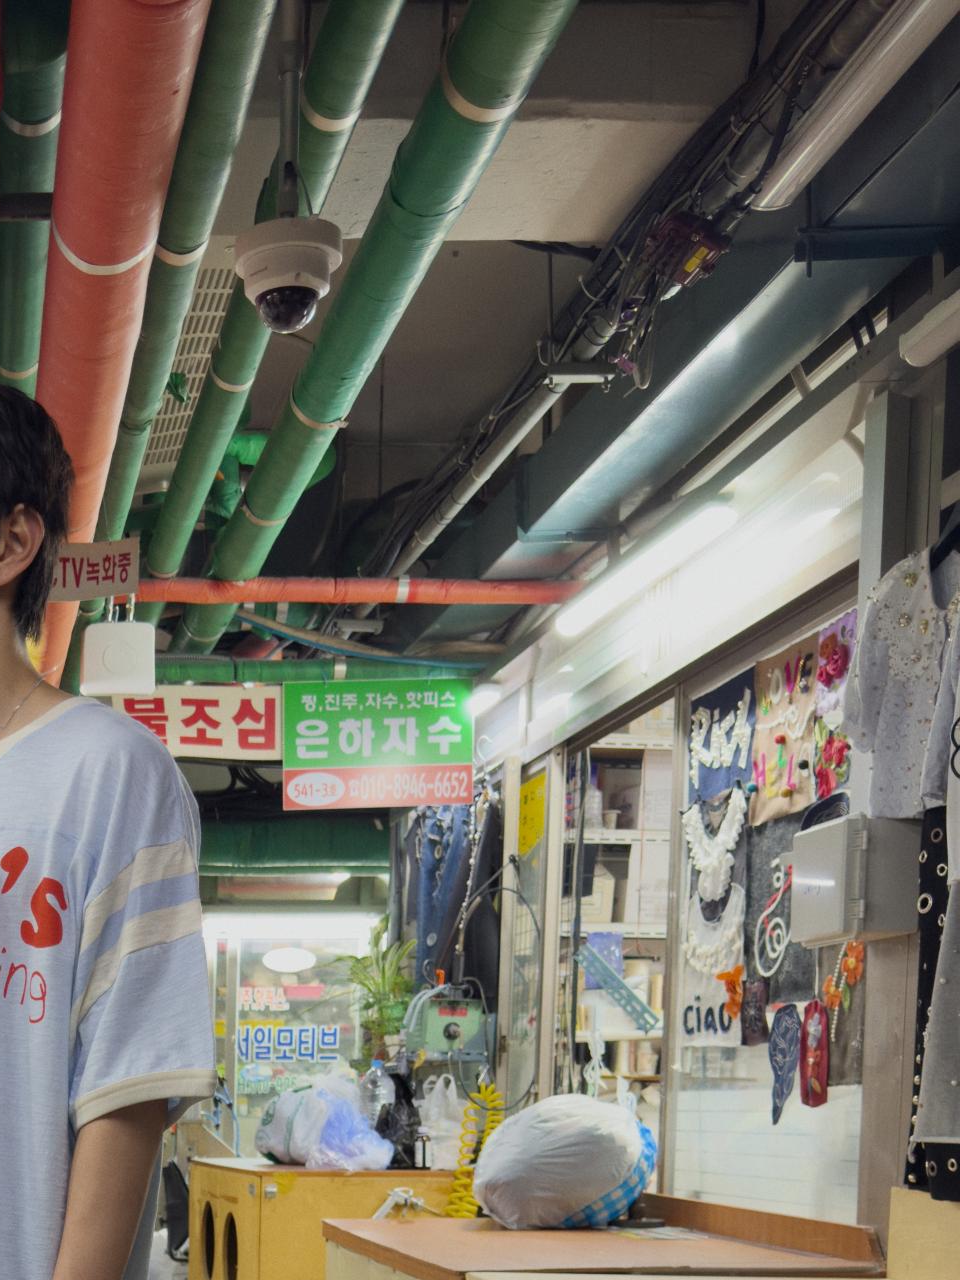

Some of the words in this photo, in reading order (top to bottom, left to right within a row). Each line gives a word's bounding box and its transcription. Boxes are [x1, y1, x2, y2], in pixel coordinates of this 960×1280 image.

[53, 552, 131, 588] TV녹화중
[124, 697, 276, 750] 불조심
[295, 716, 462, 760] 은하자수
